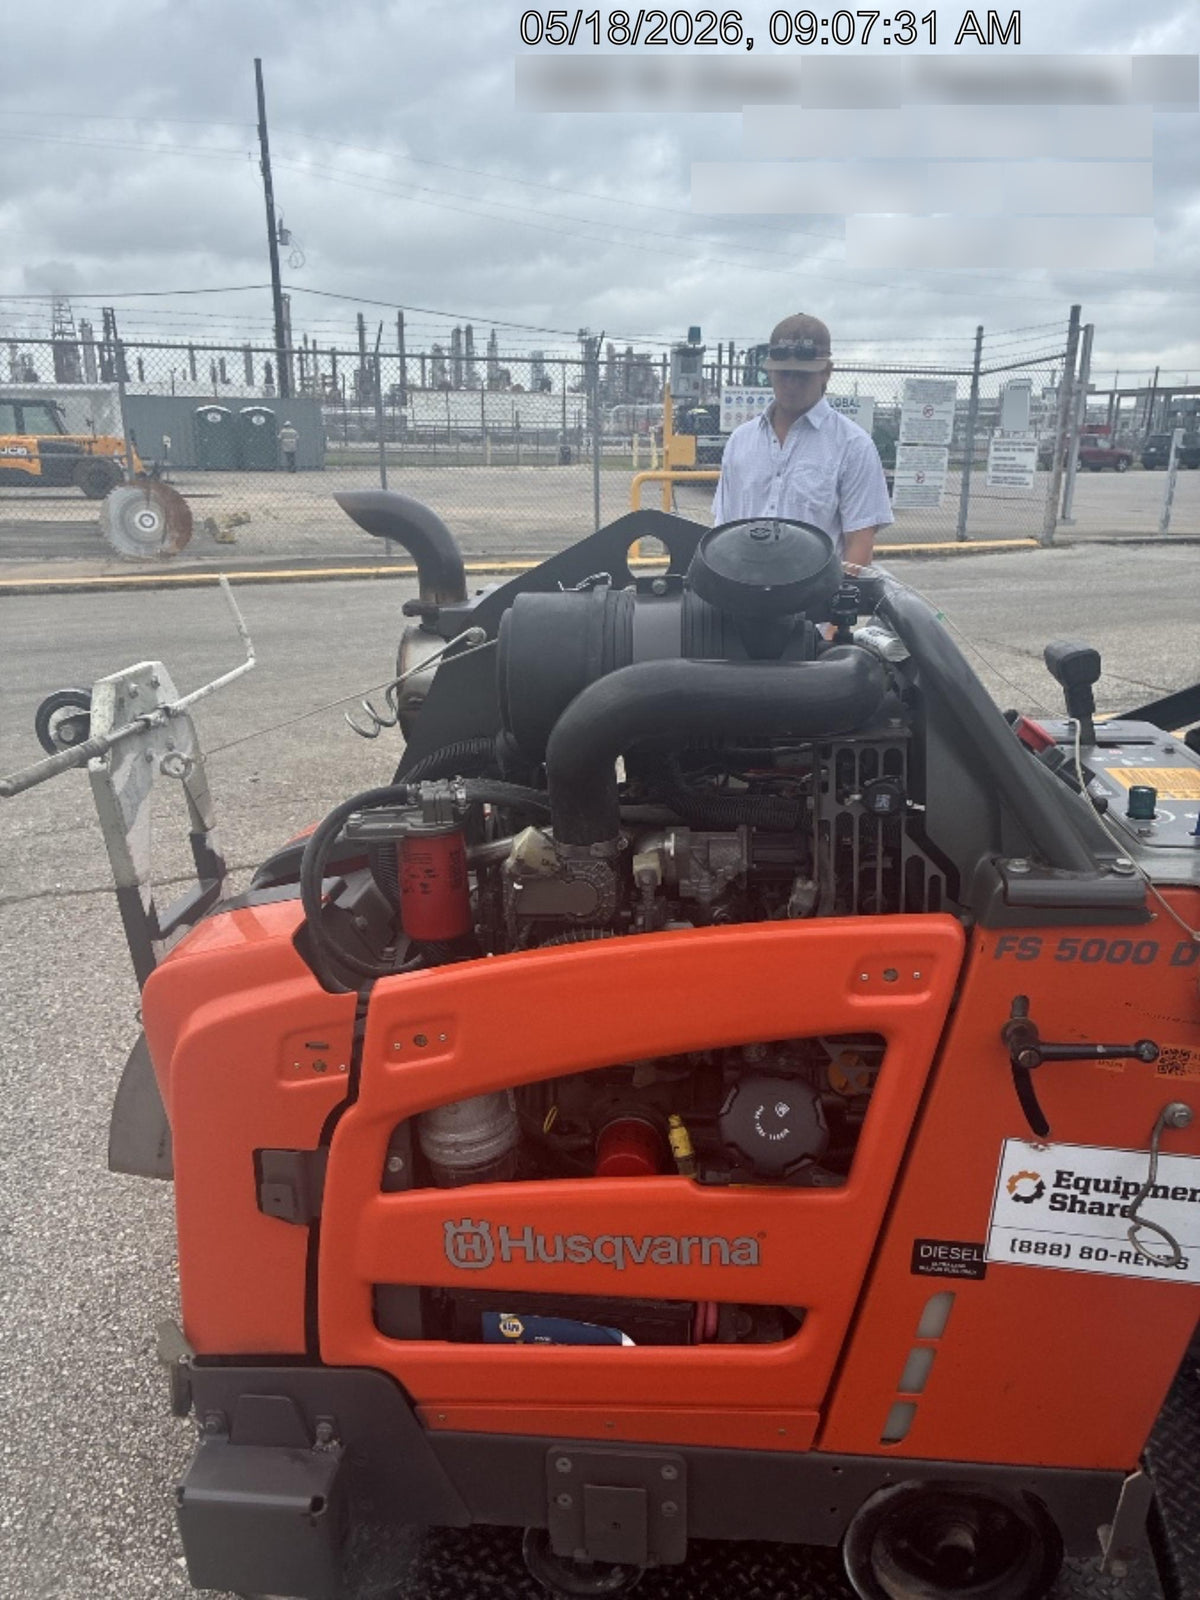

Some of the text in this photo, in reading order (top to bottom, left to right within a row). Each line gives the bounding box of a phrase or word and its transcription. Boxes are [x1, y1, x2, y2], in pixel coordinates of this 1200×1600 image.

[827, 398, 861, 408] LOBAL
[994, 936, 1200, 967] FS 5000 D
[1052, 1169, 1200, 1203] Equipmen
[1049, 1192, 1136, 1219] Share
[498, 1226, 760, 1270] Husqvarna
[920, 1245, 981, 1262] DIESEL
[1010, 1238, 1072, 1259] (888)
